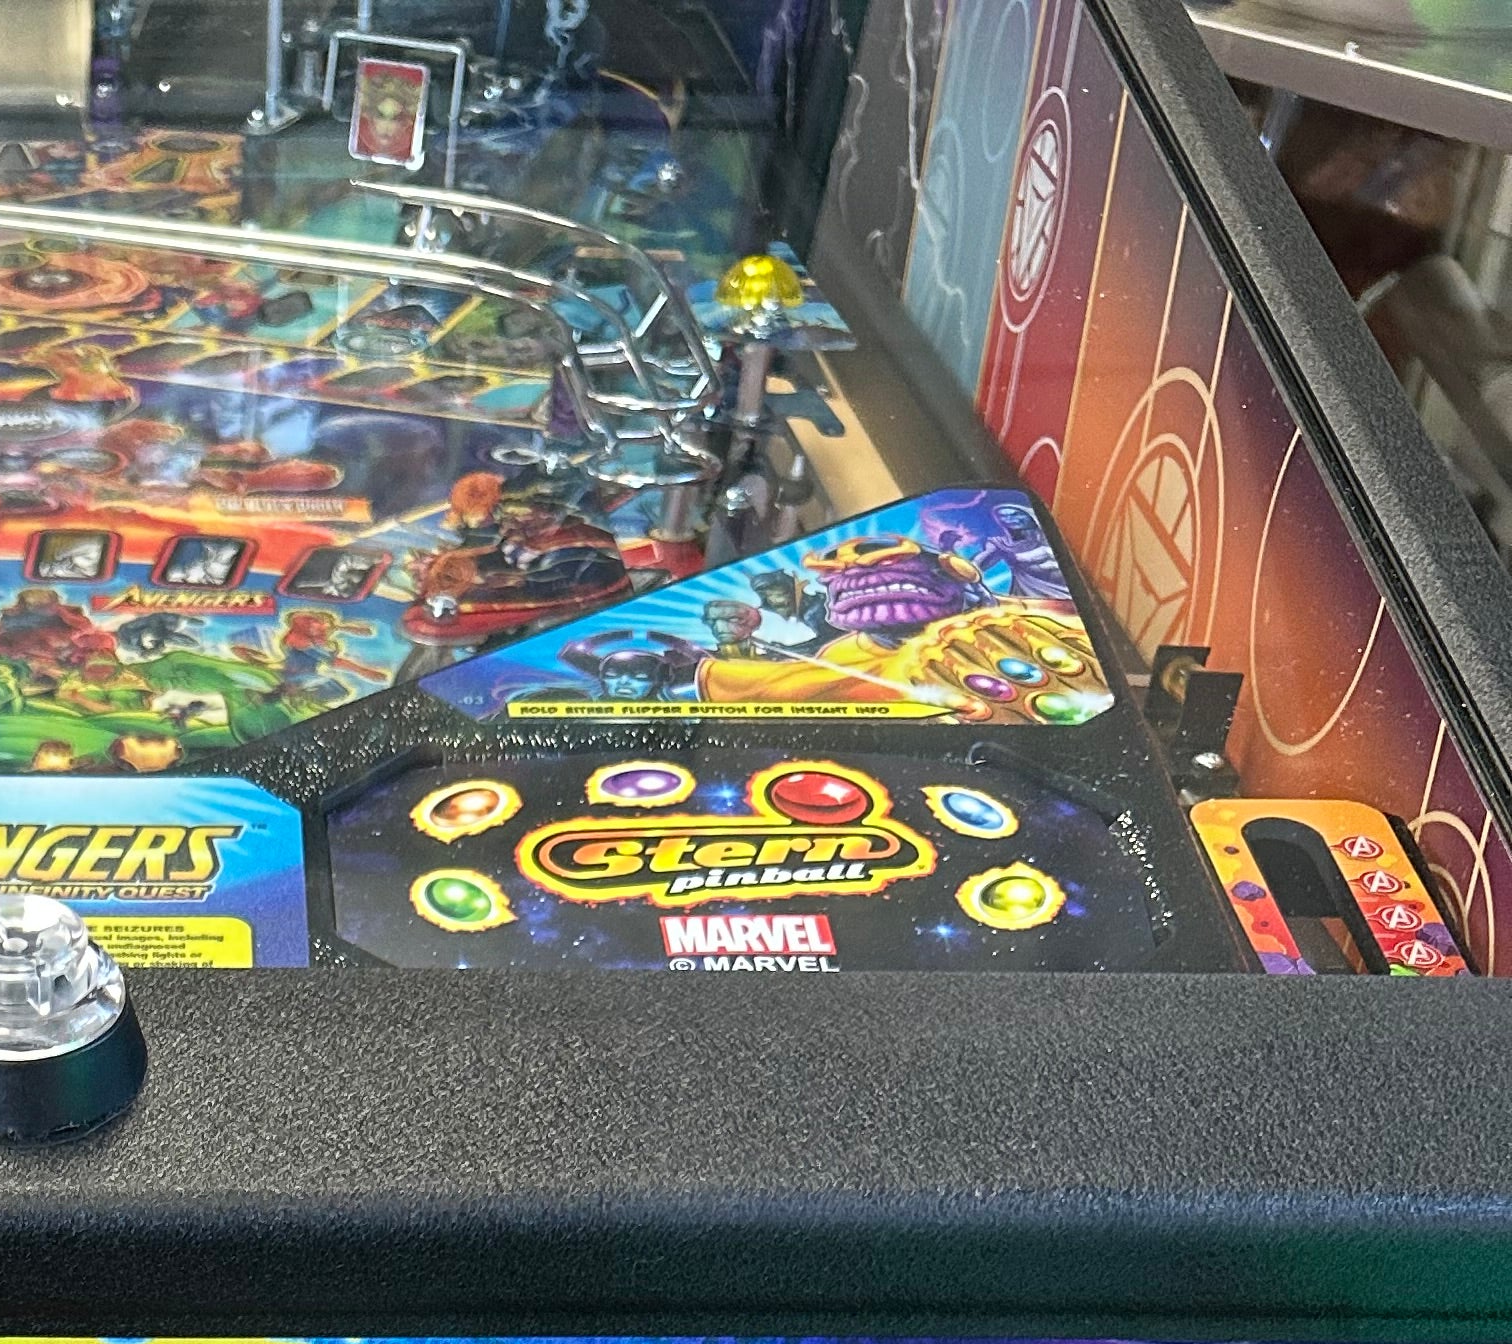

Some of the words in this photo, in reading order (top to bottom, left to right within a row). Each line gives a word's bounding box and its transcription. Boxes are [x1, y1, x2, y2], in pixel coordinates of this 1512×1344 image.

[520, 706, 559, 714] HOLD
[621, 706, 682, 714] FLIPPER
[689, 706, 747, 714] BUTTON
[754, 706, 783, 714] FOR
[791, 706, 848, 714] INSTANT
[855, 706, 890, 714] INFO
[568, 834, 890, 881] Stern
[667, 862, 867, 894] pinball
[118, 885, 205, 899] QUEST
[664, 916, 833, 953] MARVEL
[704, 956, 840, 973] MARVEL
